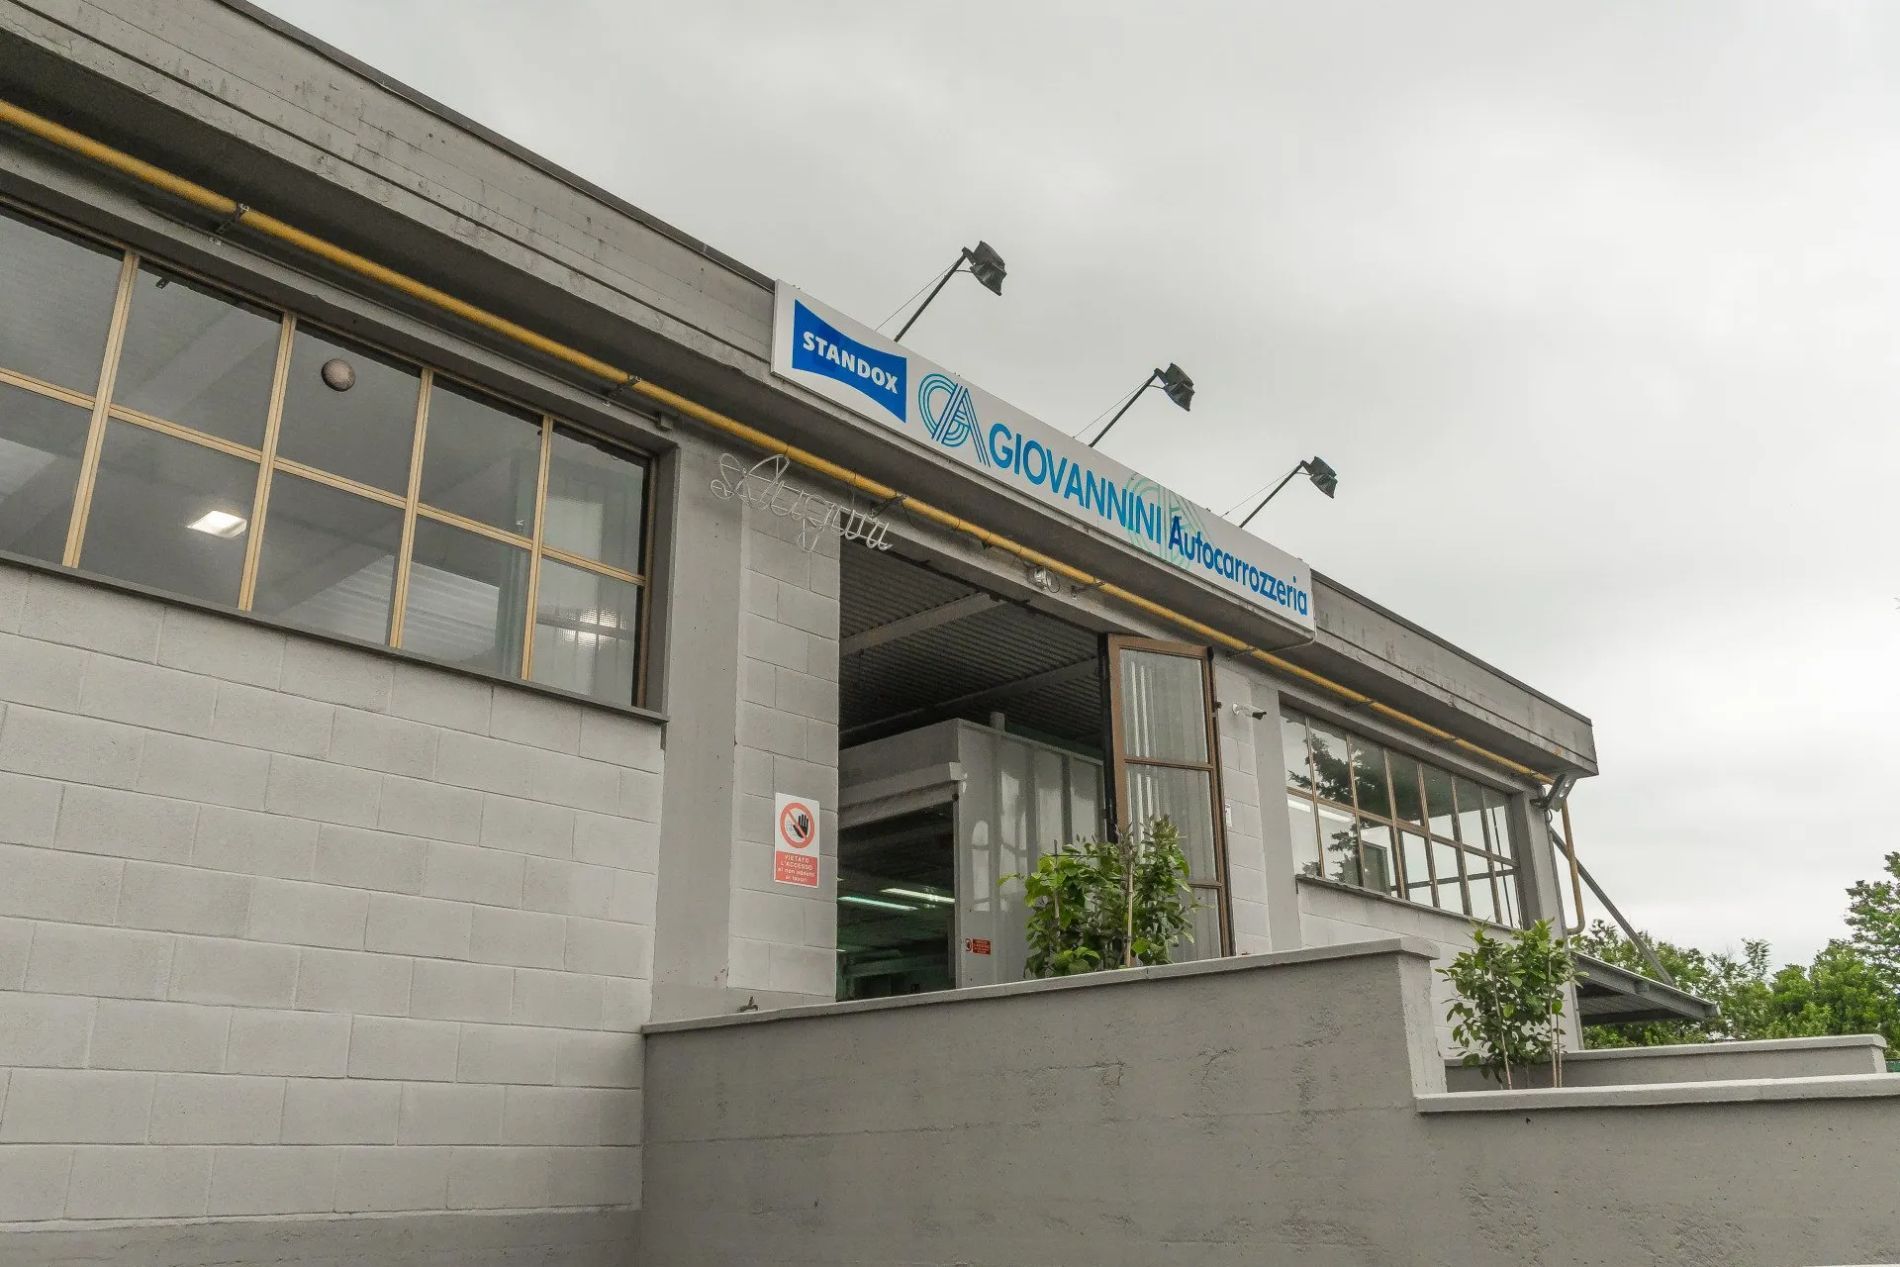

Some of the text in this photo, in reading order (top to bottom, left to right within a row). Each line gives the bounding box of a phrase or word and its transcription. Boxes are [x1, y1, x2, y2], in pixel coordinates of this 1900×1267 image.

[803, 331, 898, 394] STANDOX
[989, 423, 1308, 616] GIOVANNINI Autocarrozzeria
[784, 854, 810, 863] VIETATO
